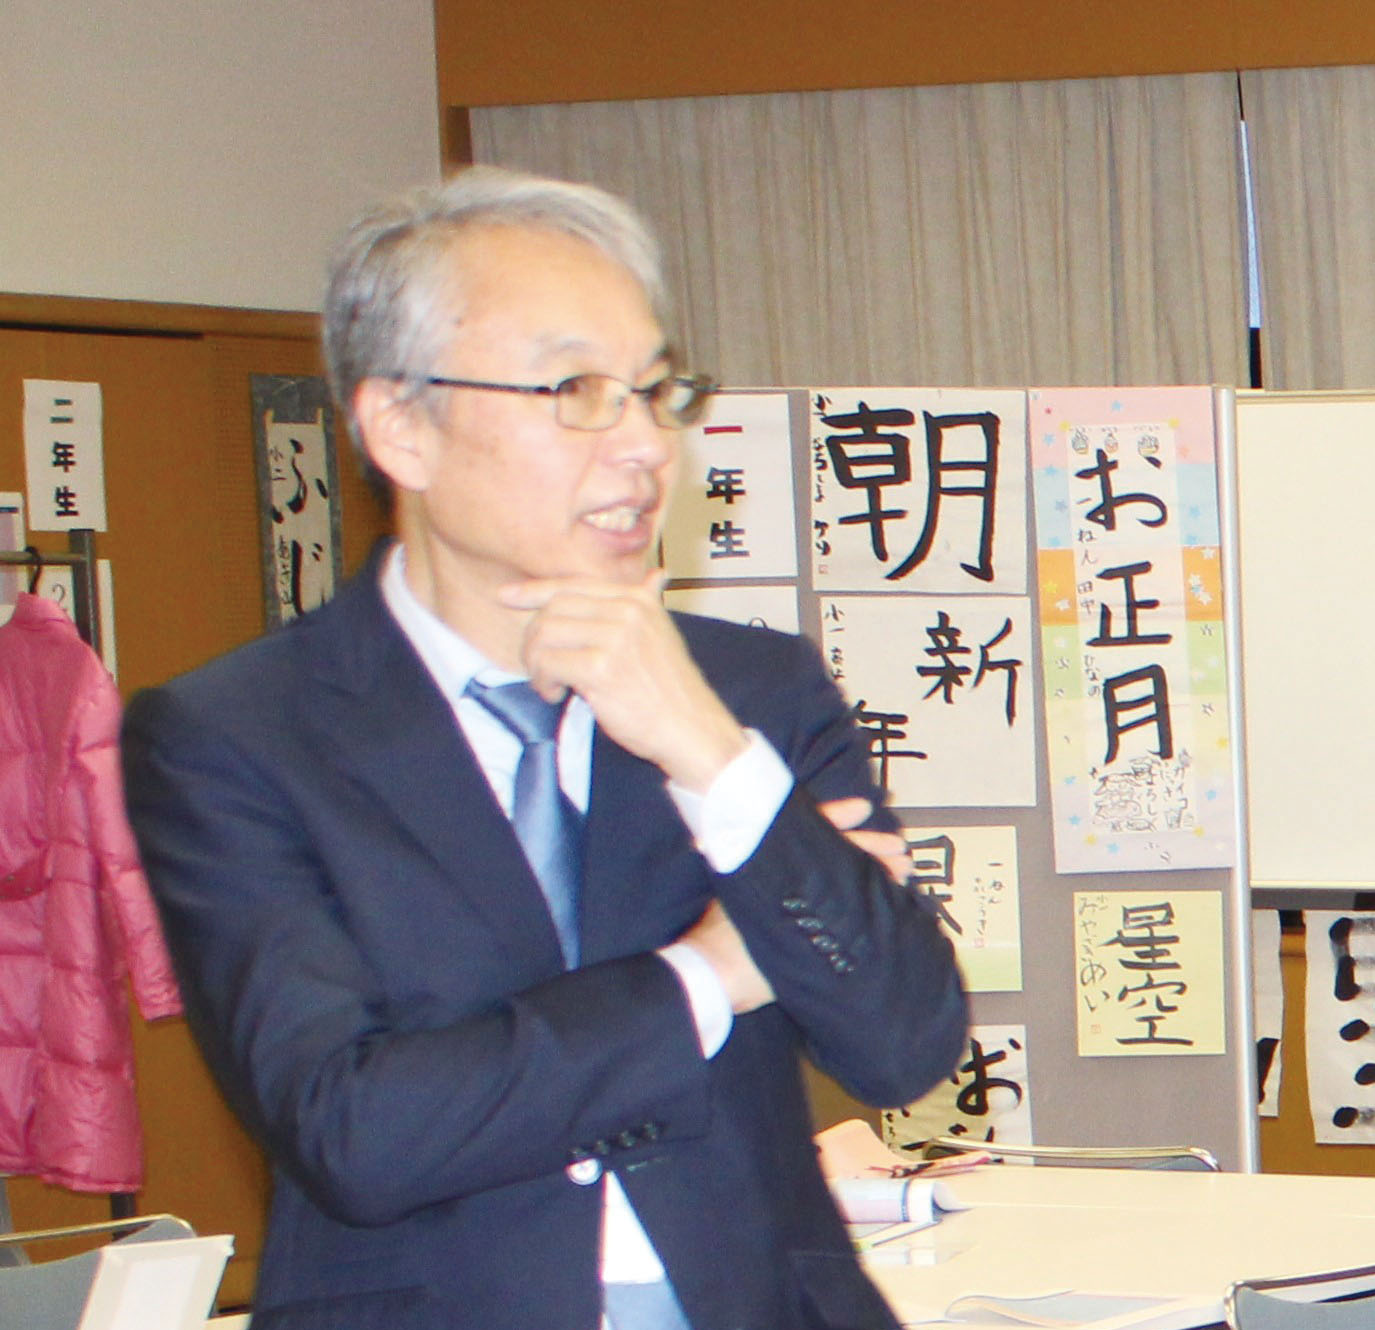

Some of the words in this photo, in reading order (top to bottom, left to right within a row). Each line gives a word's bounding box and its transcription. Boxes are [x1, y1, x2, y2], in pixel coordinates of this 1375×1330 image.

[51, 398, 79, 518] 二年生
[703, 425, 750, 559] 一年生
[823, 401, 1002, 581] 朝
[824, 603, 846, 633] 小一
[1074, 448, 1175, 764] お正月
[1077, 580, 1097, 614] 田中
[915, 609, 1024, 728] 新
[1098, 902, 1194, 1046] 星空
